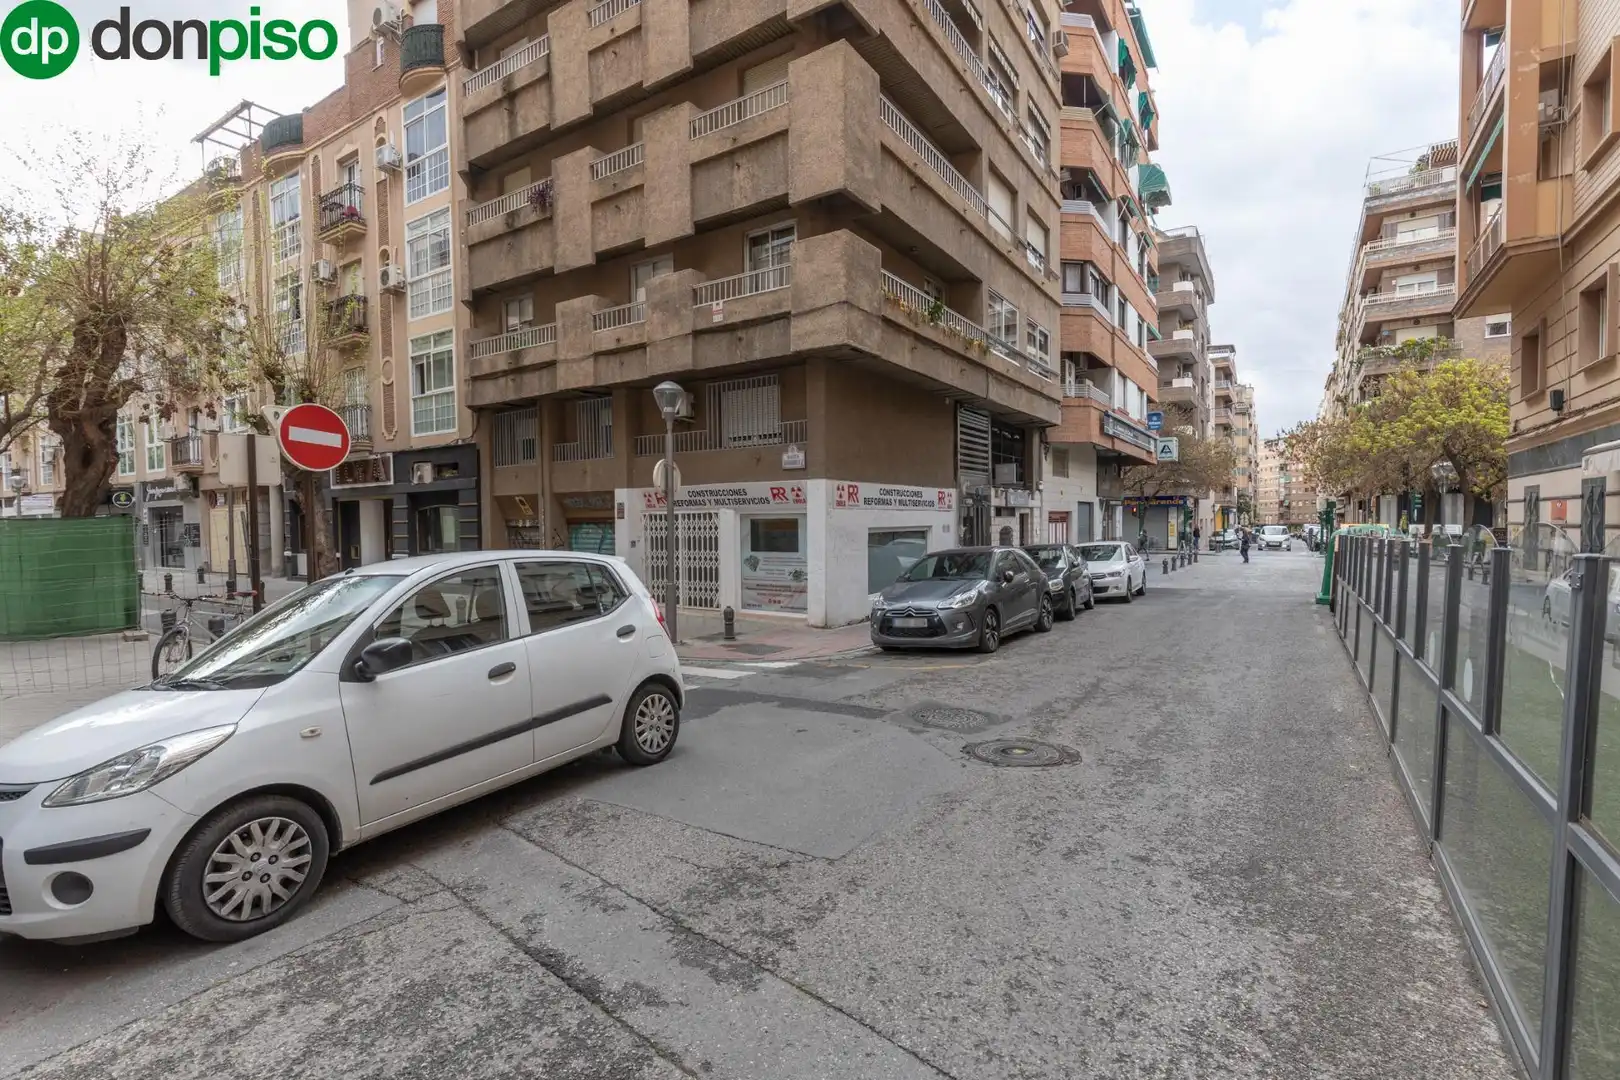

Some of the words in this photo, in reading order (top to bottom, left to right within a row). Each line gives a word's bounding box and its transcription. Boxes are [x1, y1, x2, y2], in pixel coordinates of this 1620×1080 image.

[687, 488, 748, 498] CONSTRUCCIONES
[770, 486, 789, 502] RR
[879, 488, 923, 499] CONSTRUCCIONES
[673, 498, 707, 507] REFORMAS
[714, 497, 771, 506] MULTISERVICIOS
[864, 497, 892, 506] REFORMAS
[898, 498, 936, 508] MULTISERVICIOS
